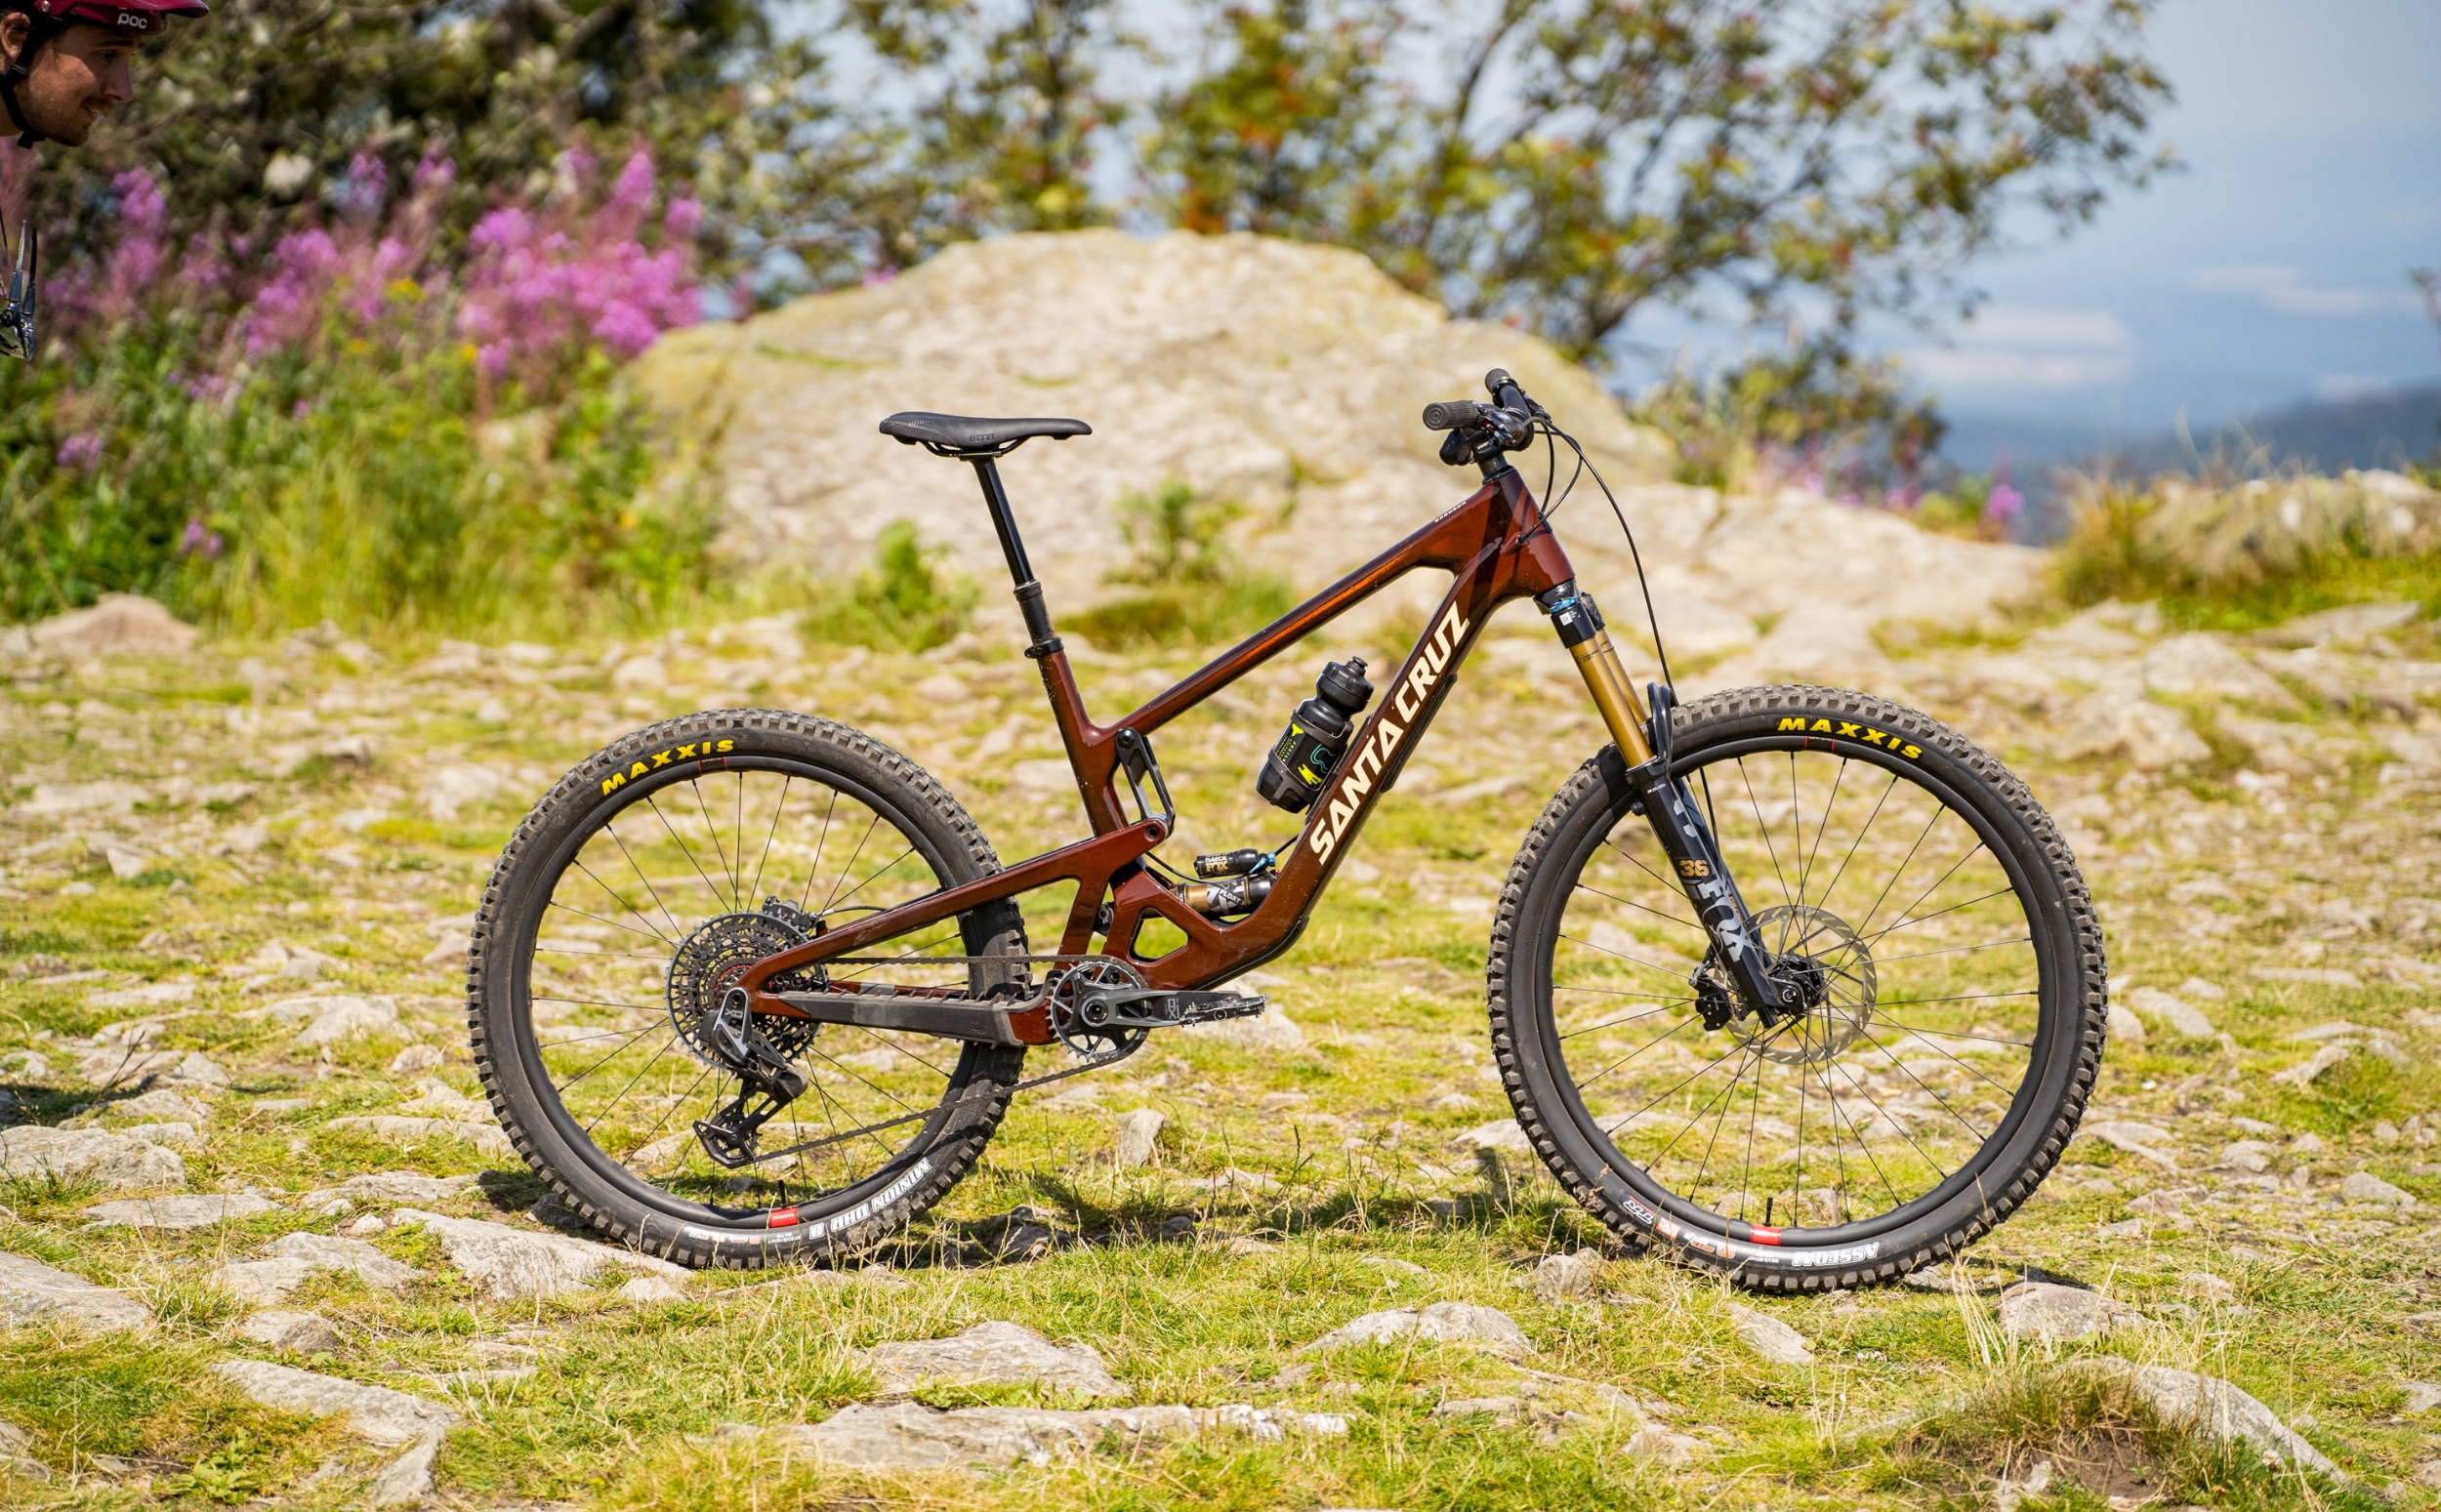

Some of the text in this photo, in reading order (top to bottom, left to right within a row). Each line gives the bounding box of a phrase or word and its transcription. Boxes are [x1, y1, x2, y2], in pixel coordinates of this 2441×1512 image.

[1310, 600, 1470, 866] SANTA CRUZ
[1777, 717, 1924, 759] MAXXIS
[601, 739, 734, 796] MAXXIS
[1678, 860, 1709, 877] 36
[1220, 889, 1241, 904] FLOAT
[1697, 879, 1755, 962] FOX
[871, 1158, 931, 1212] MINION
[830, 1203, 871, 1233] DHR
[1792, 1242, 1880, 1266] ASSEGAI
